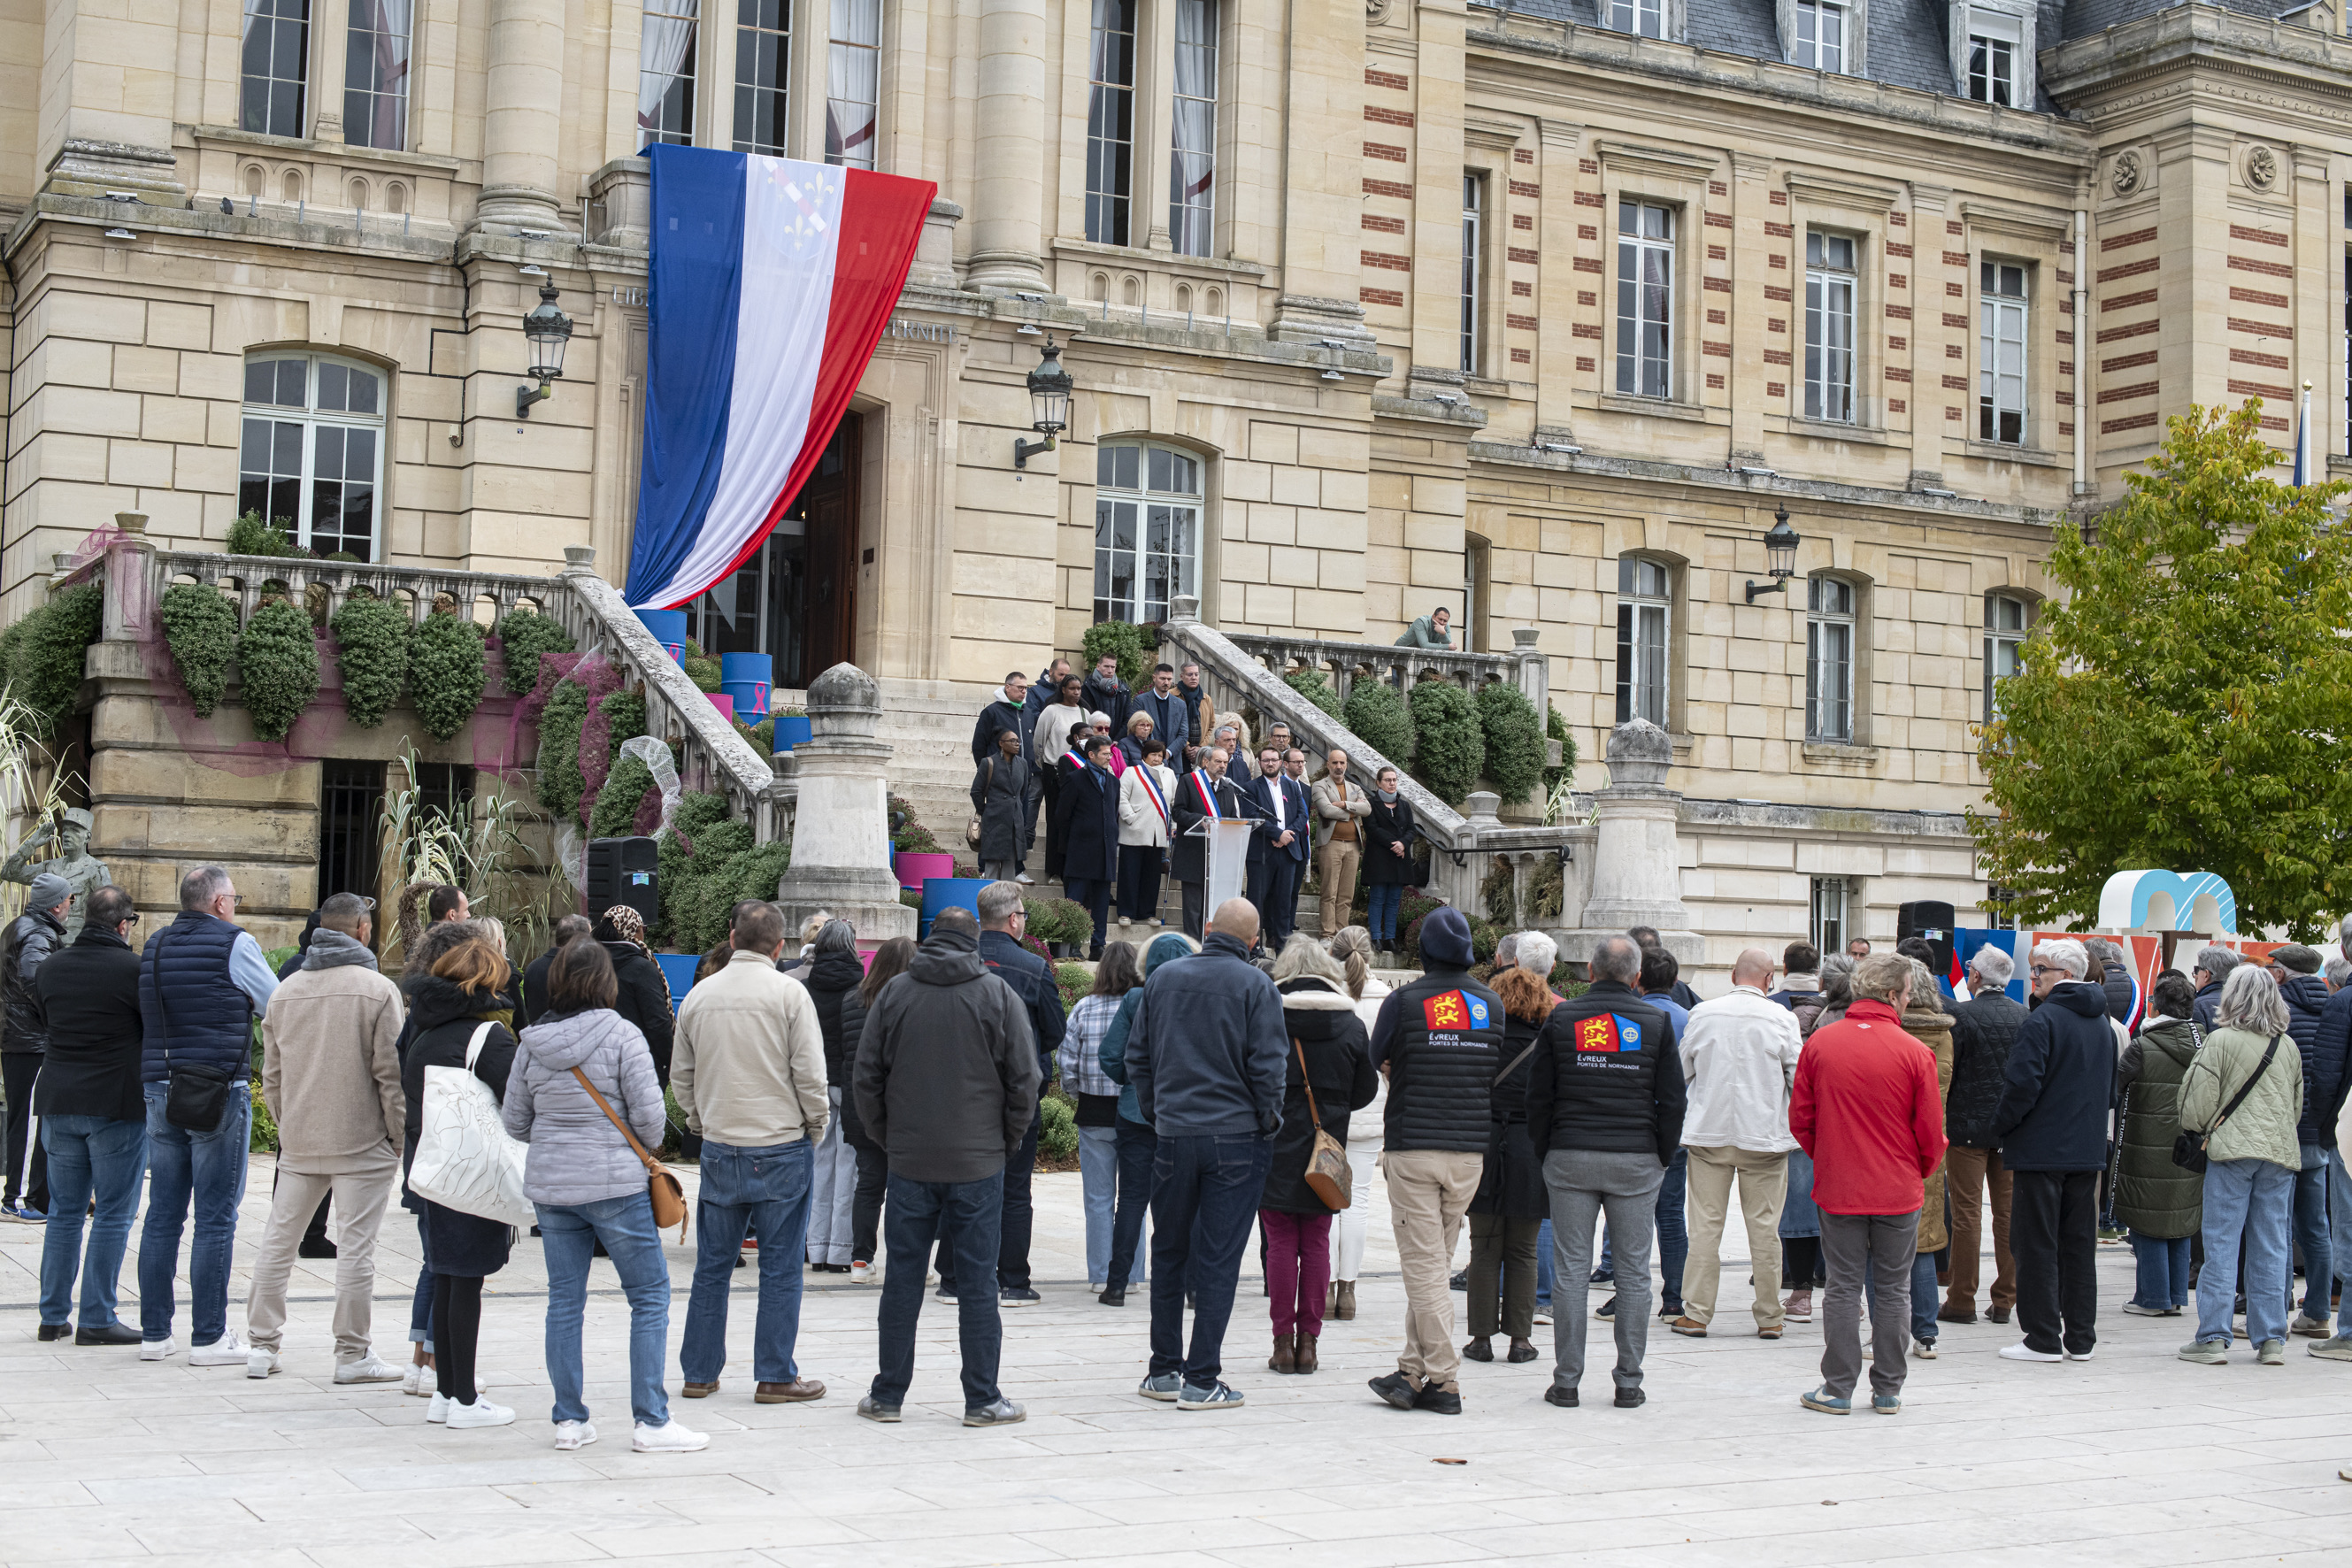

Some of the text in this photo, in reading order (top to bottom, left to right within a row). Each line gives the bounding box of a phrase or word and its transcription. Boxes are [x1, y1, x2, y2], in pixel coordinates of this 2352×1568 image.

[611, 285, 649, 307] LIB
[883, 319, 958, 344] ERNITÉ
[2187, 1022, 2202, 1048] STUDIO
